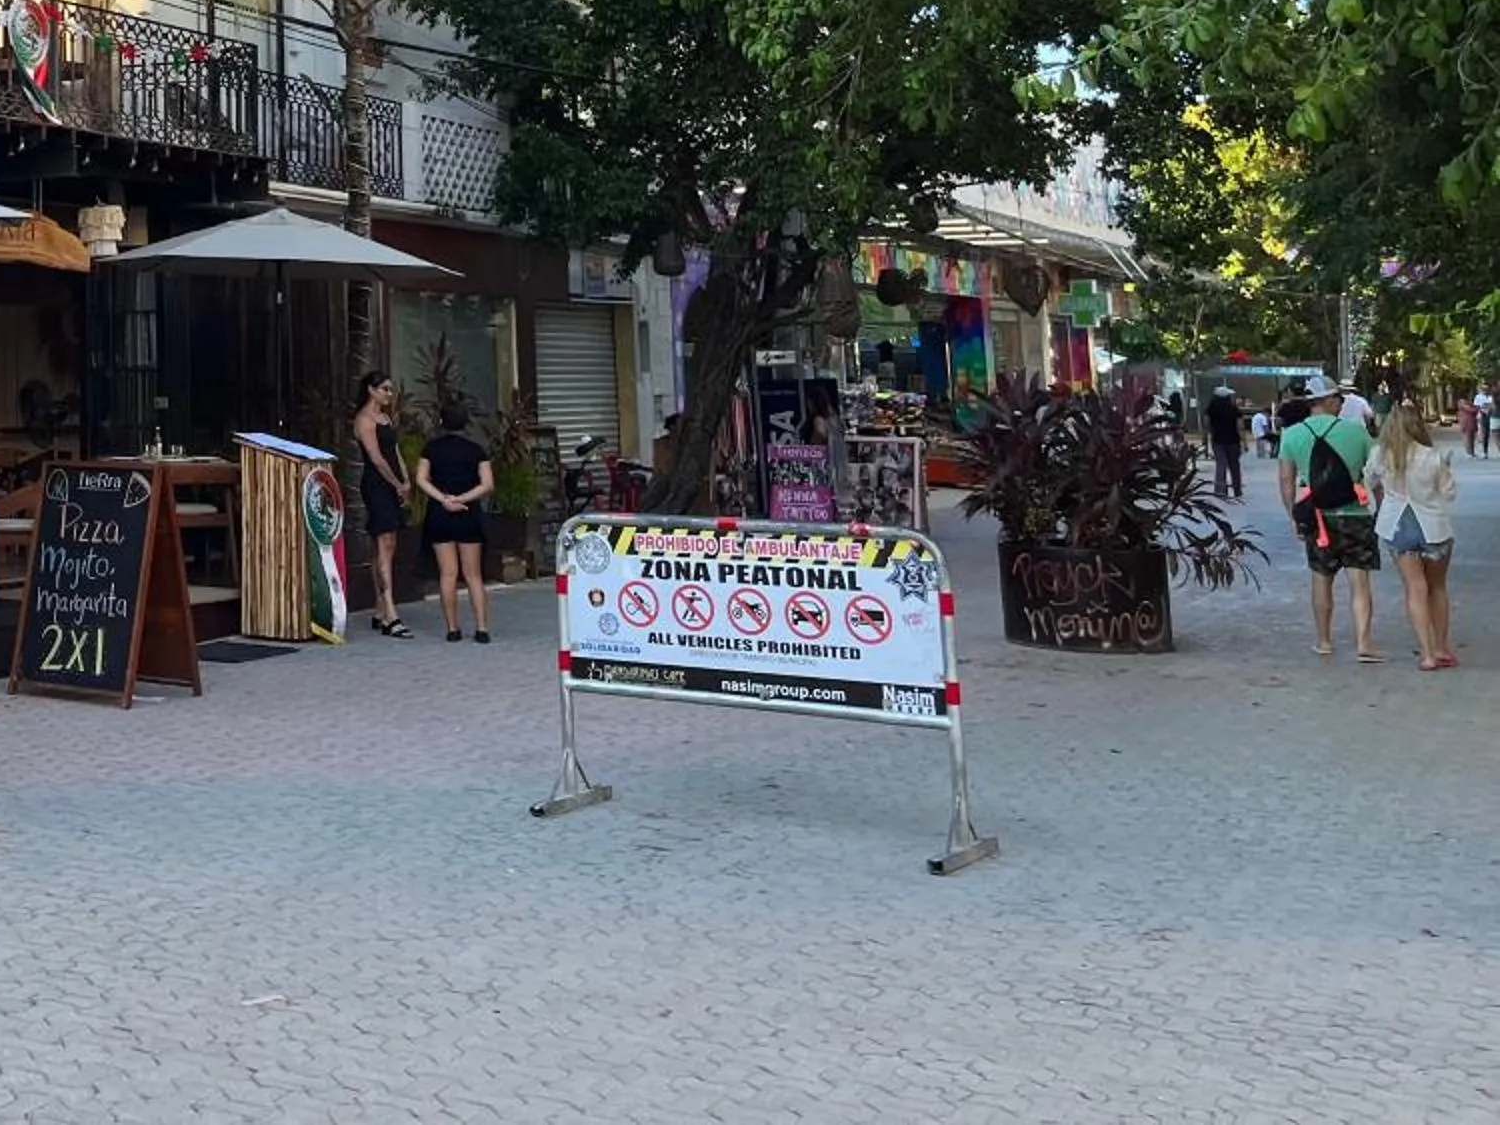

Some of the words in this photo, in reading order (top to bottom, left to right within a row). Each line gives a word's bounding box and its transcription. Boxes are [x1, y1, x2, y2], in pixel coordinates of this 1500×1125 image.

[635, 535, 718, 554] PROHIBIDO
[720, 538, 740, 554] EL
[745, 540, 862, 560] AMBULANTAJE
[640, 559, 711, 582] ZONA
[718, 563, 863, 591] PEATONAL
[647, 632, 674, 646] ALL
[678, 634, 753, 652] VEHICLES
[757, 640, 861, 660] PROHIBITED
[720, 679, 846, 702] nasimgroup.com
[883, 685, 935, 707] Nasim
